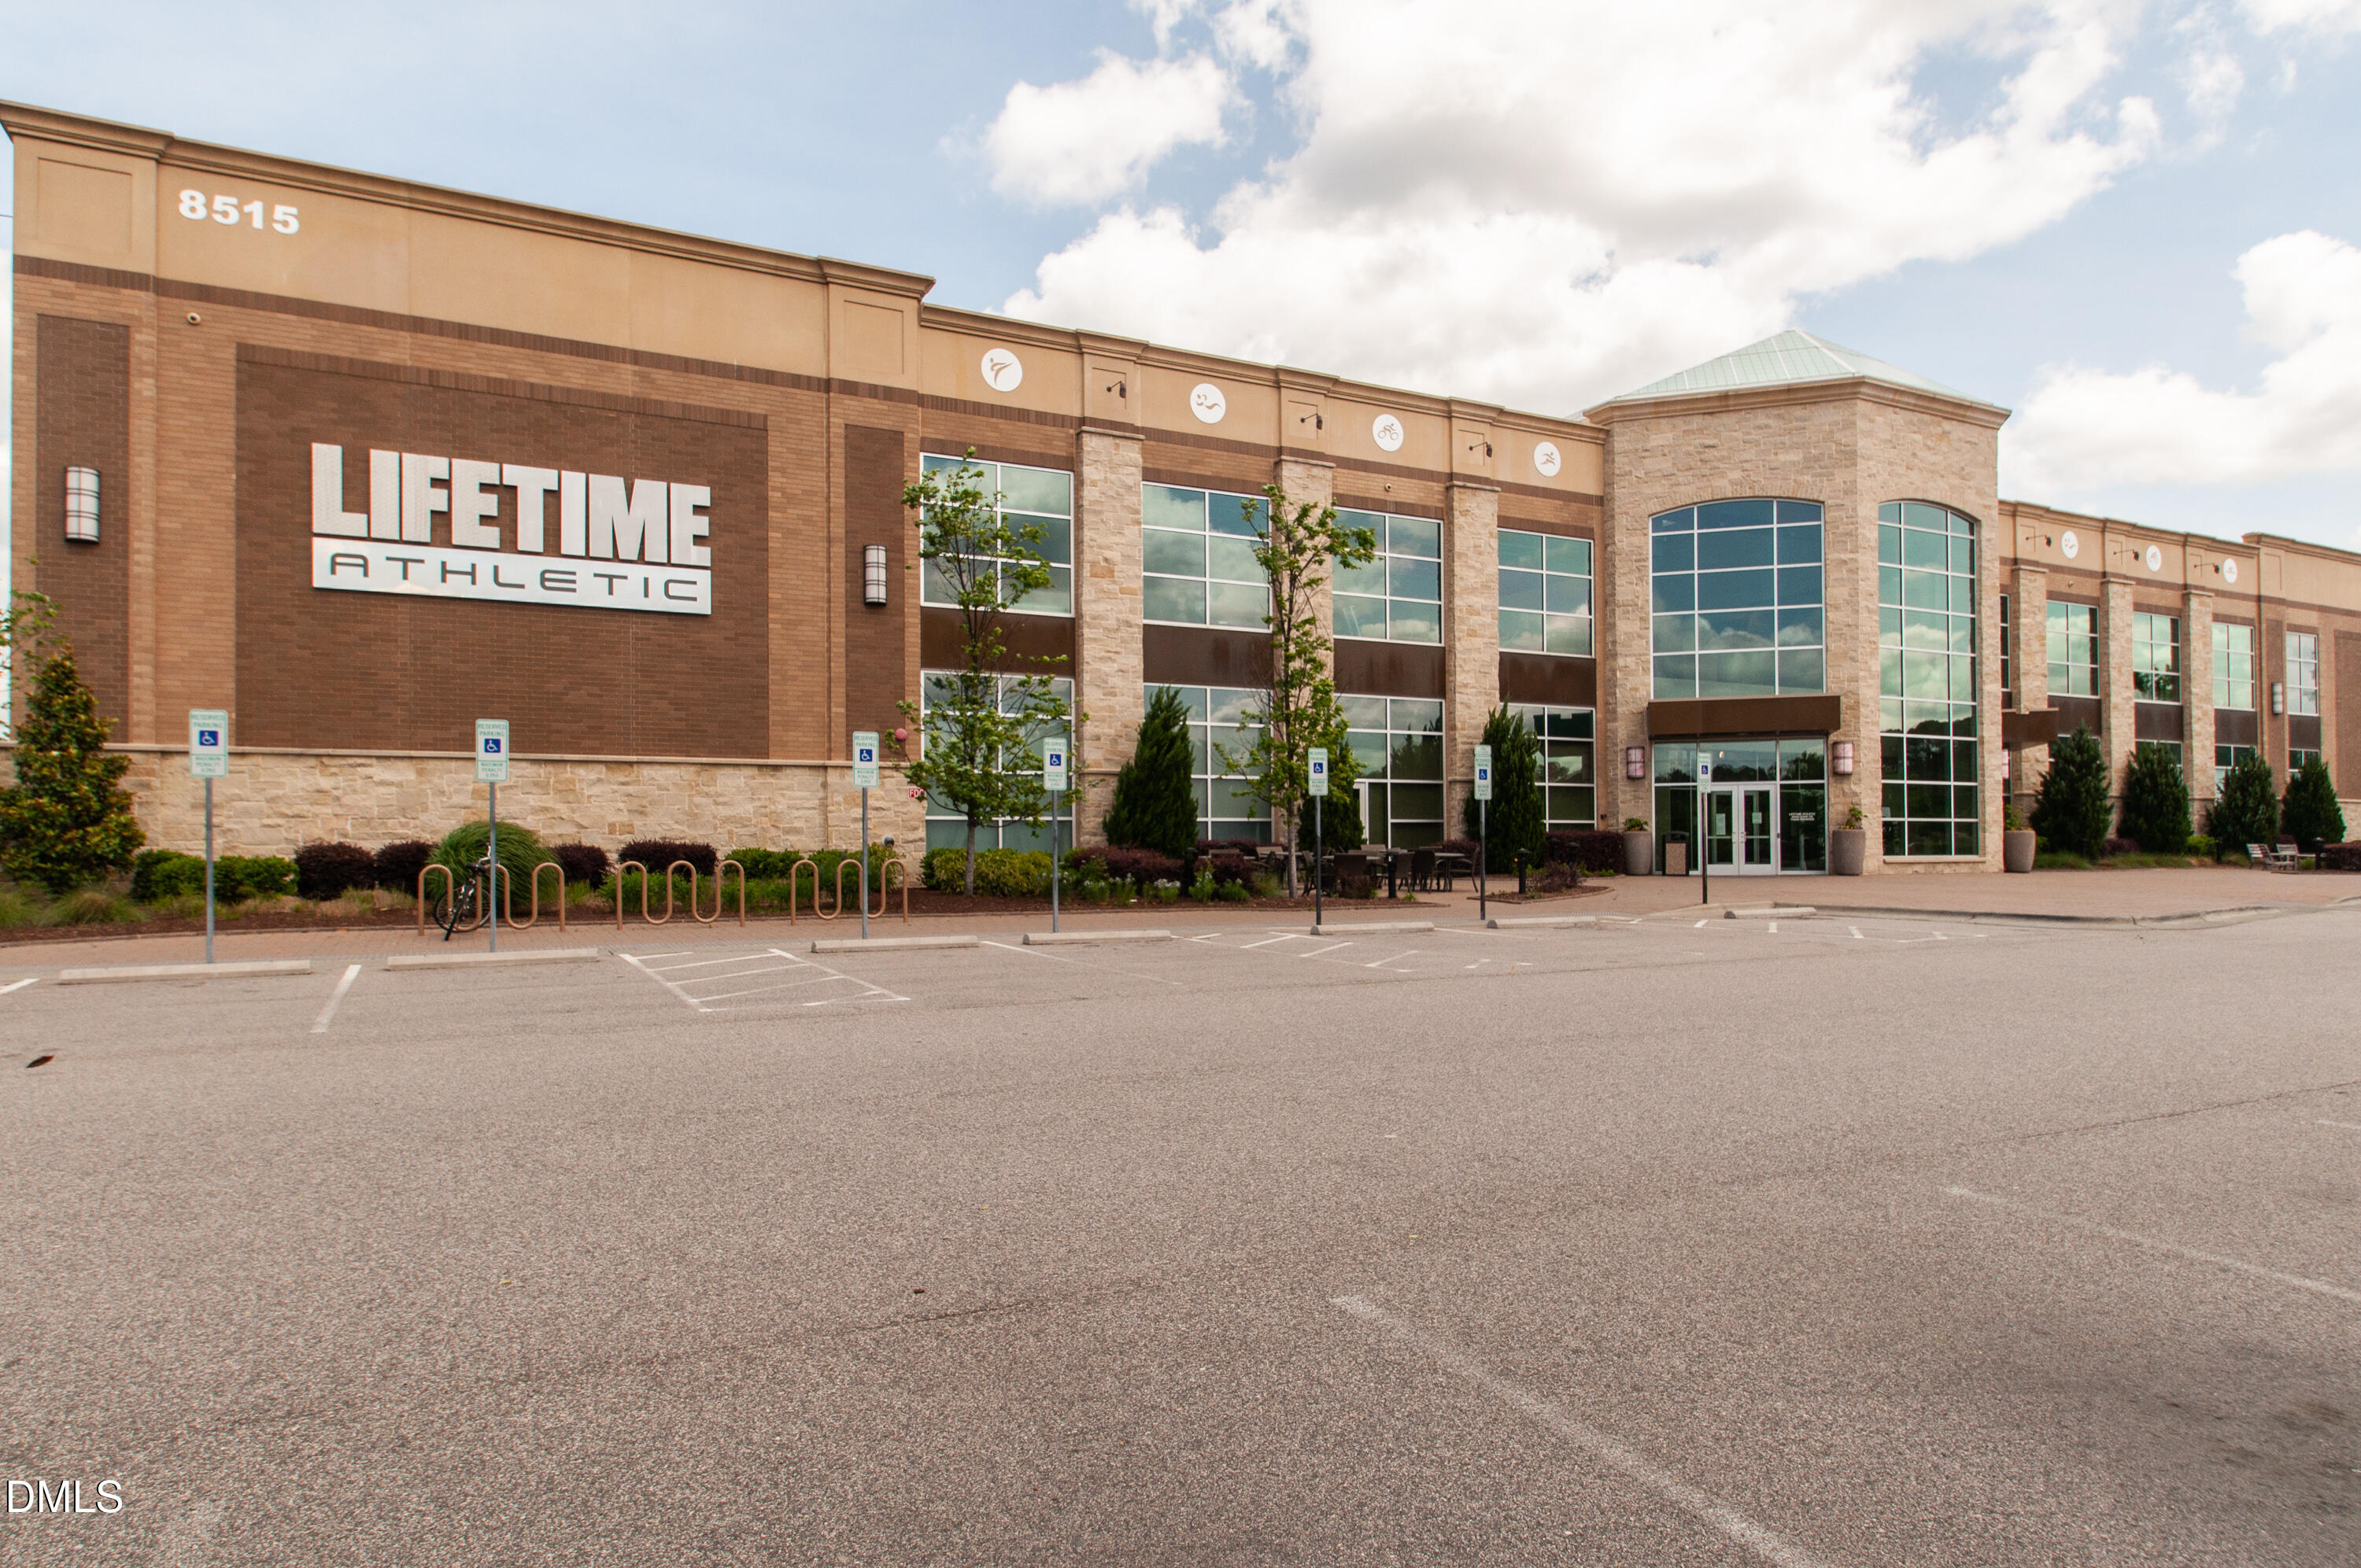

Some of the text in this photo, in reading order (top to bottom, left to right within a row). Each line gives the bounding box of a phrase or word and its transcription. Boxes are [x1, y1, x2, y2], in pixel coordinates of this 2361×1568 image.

[179, 189, 300, 235] 8515
[312, 442, 711, 566] LIFETIME
[330, 552, 698, 602] ATHLETIC
